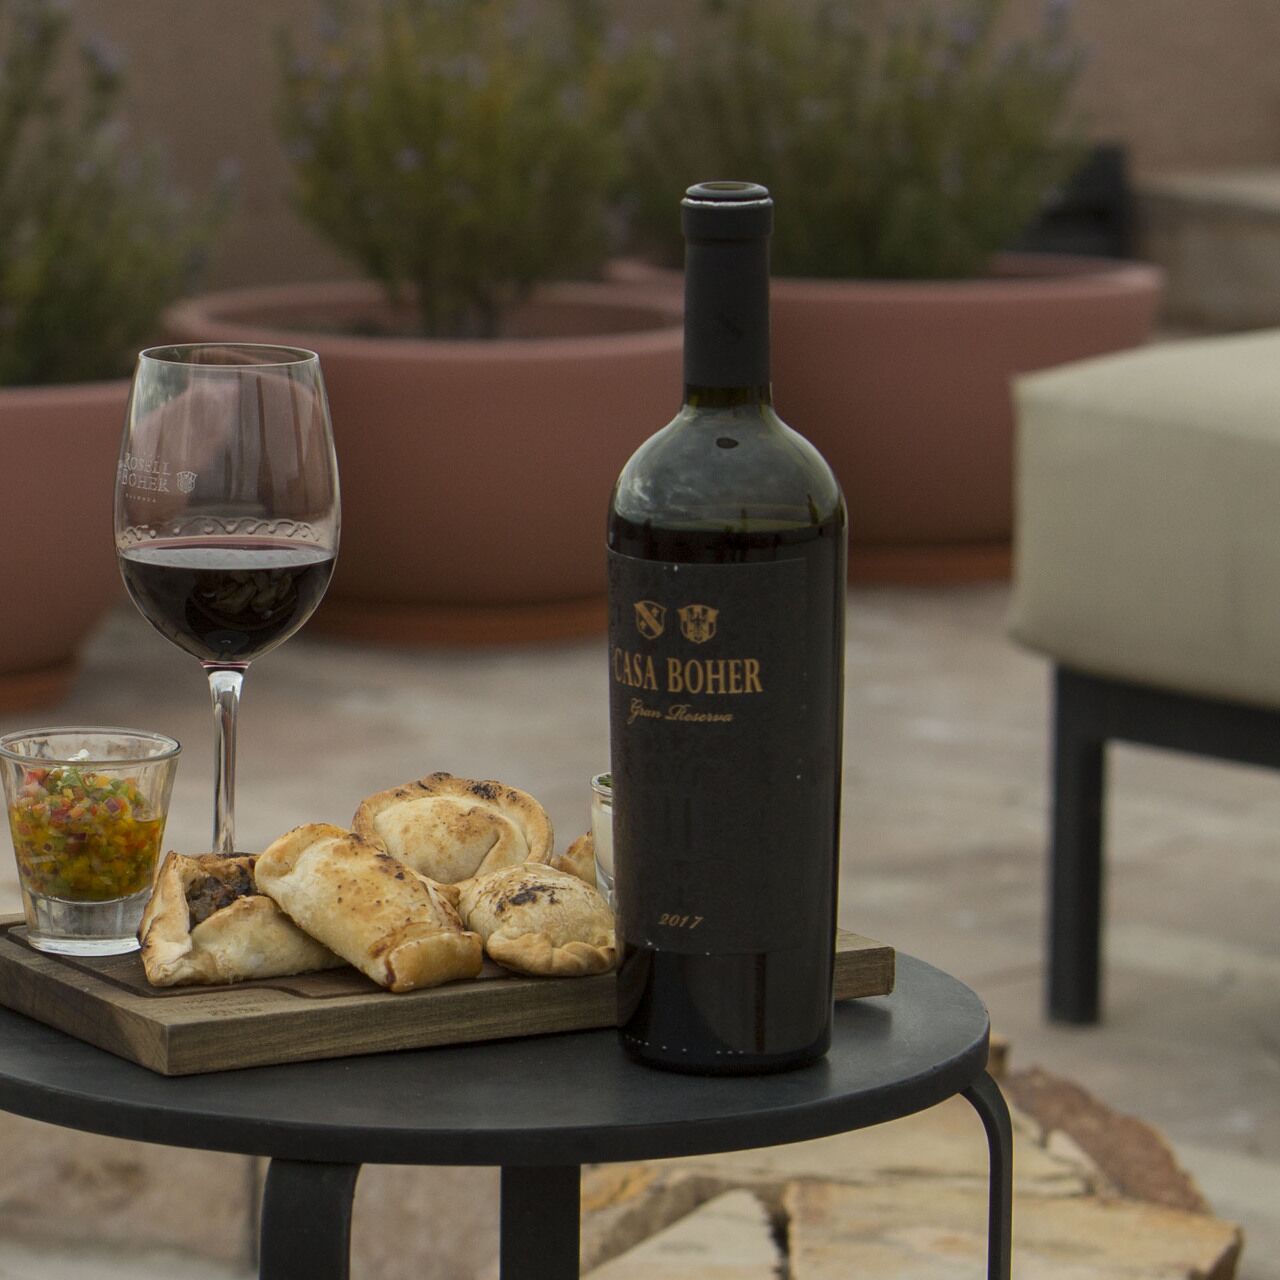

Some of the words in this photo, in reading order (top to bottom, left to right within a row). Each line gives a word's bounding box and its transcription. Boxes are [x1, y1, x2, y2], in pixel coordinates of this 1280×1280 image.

[613, 647, 659, 691] CASA
[666, 657, 764, 695] BOHER
[626, 697, 663, 726] Gran
[665, 703, 734, 723] Reserva
[657, 912, 705, 929] 2017
